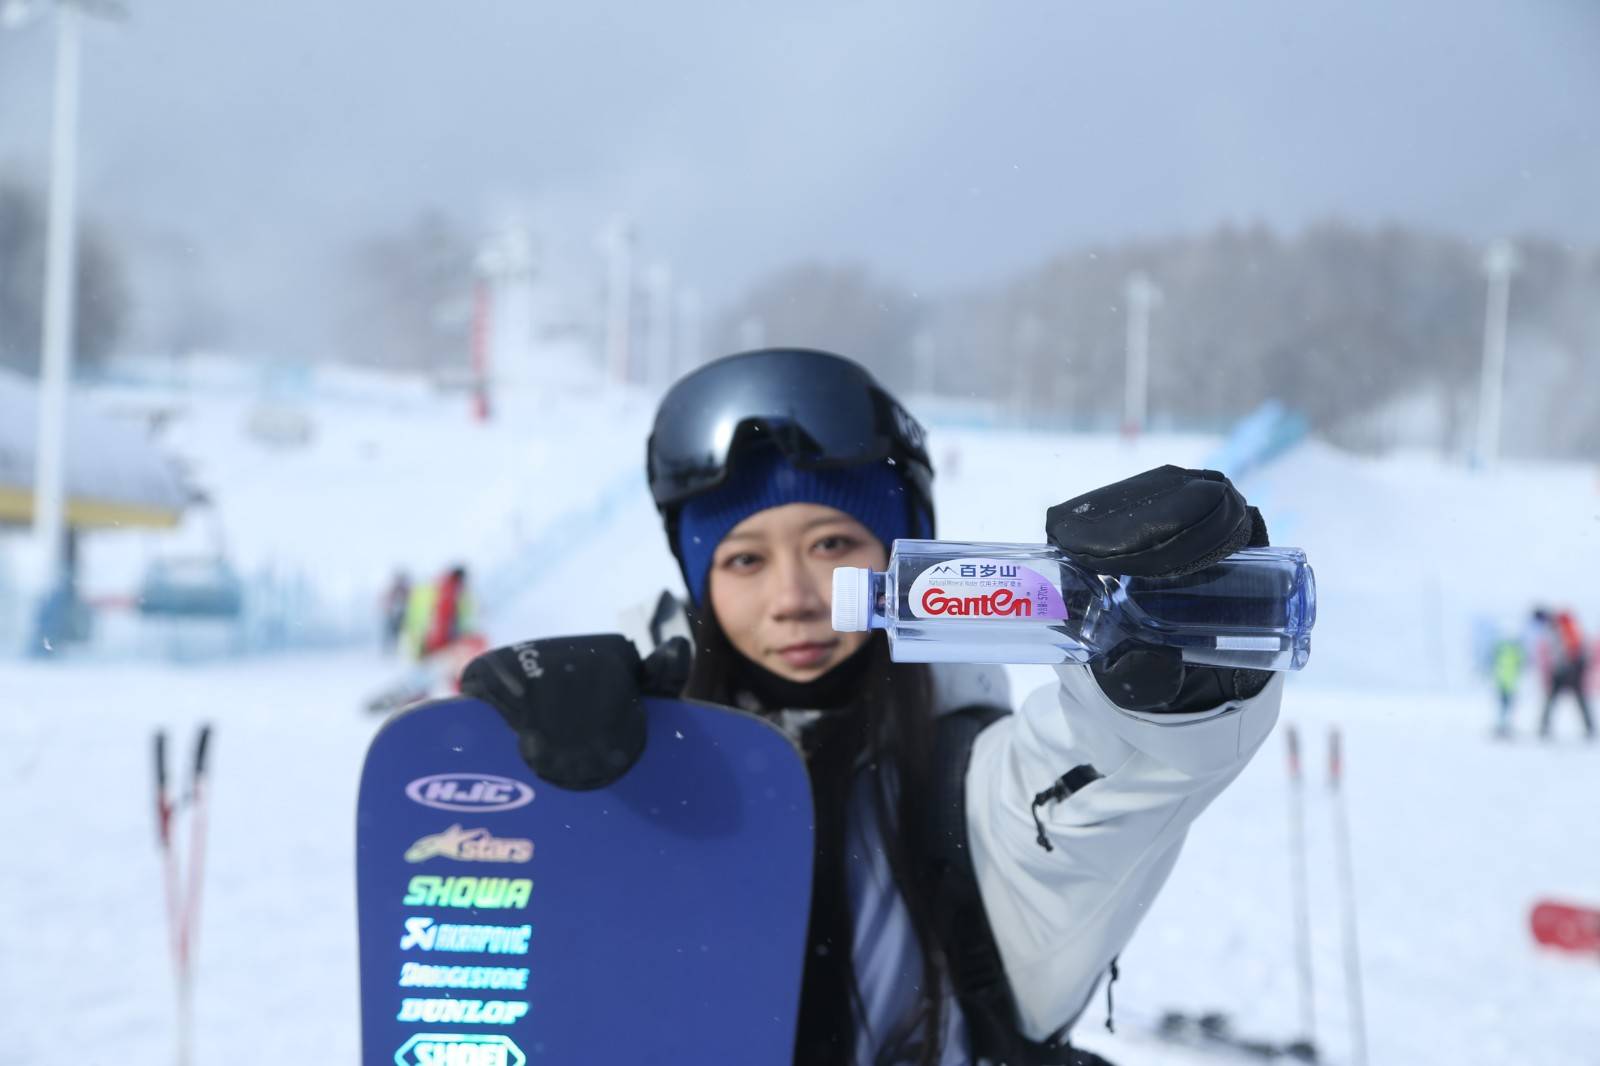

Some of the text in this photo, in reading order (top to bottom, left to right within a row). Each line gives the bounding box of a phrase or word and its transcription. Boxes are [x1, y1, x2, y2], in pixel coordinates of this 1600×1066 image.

[960, 564, 1017, 578] 百岁山
[425, 780, 515, 802] HJC
[402, 875, 534, 909] SHOWA
[396, 997, 530, 1024] DUNLOP
